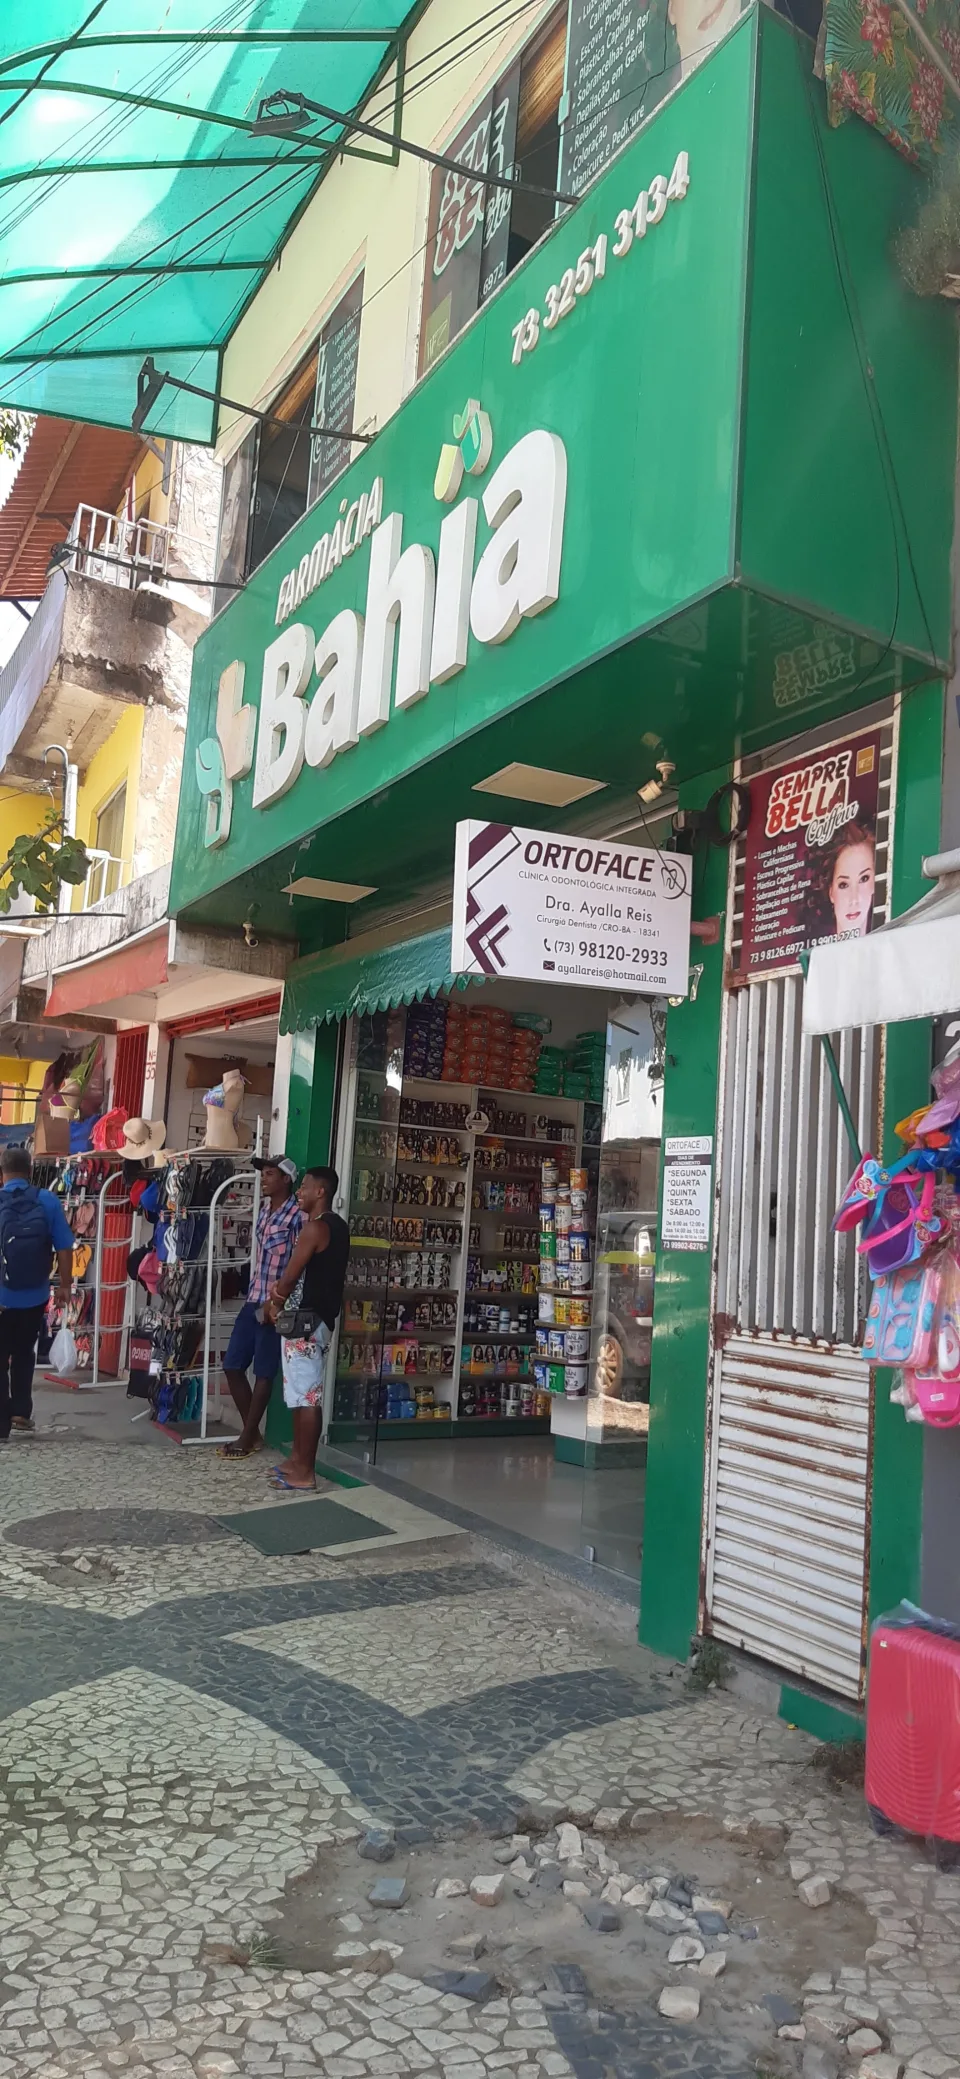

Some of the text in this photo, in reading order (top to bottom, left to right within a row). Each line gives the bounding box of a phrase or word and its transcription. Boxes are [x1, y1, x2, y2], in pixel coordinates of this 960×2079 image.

[606, 9, 632, 49] Capilar
[580, 26, 604, 63] Escova
[576, 31, 646, 127] Depilação em Geral
[577, 41, 624, 107] Sobrancelhas
[625, 28, 635, 48] de
[572, 124, 608, 172] Coloração
[571, 150, 604, 196] Manicure
[605, 143, 610, 156] e
[511, 150, 690, 366] 73 3251 3134
[274, 475, 384, 626] FARMÁCIA
[252, 399, 568, 809] Bahia
[769, 752, 851, 804] SEMPRE
[766, 778, 848, 836] BELLA
[805, 801, 859, 846] Coiffeur
[524, 840, 655, 883] ORTOFACE
[757, 850, 772, 859] Luzes
[777, 841, 797, 853] Mechas
[762, 853, 794, 868] Californiana
[518, 870, 657, 898] CLÍNICA ODONTOLÓGICA INTEGRADA
[756, 860, 805, 880] Escova Progressiva
[776, 873, 795, 886] Capilar
[756, 880, 811, 901] Sobrancelhas de Rena
[790, 890, 805, 902] Geral
[545, 895, 653, 923] Dra. Ayalla Reis
[568, 918, 597, 930] Dentista
[639, 928, 660, 937] 18341
[782, 924, 806, 936] Pedicure
[554, 940, 668, 967] (73) 98120-2933
[750, 952, 759, 964] 73
[759, 951, 765, 962] 9
[765, 941, 804, 960] 8126.6972
[557, 964, 667, 984] ayallareis@hotmail.com
[667, 1140, 701, 1150] ORTOFACE
